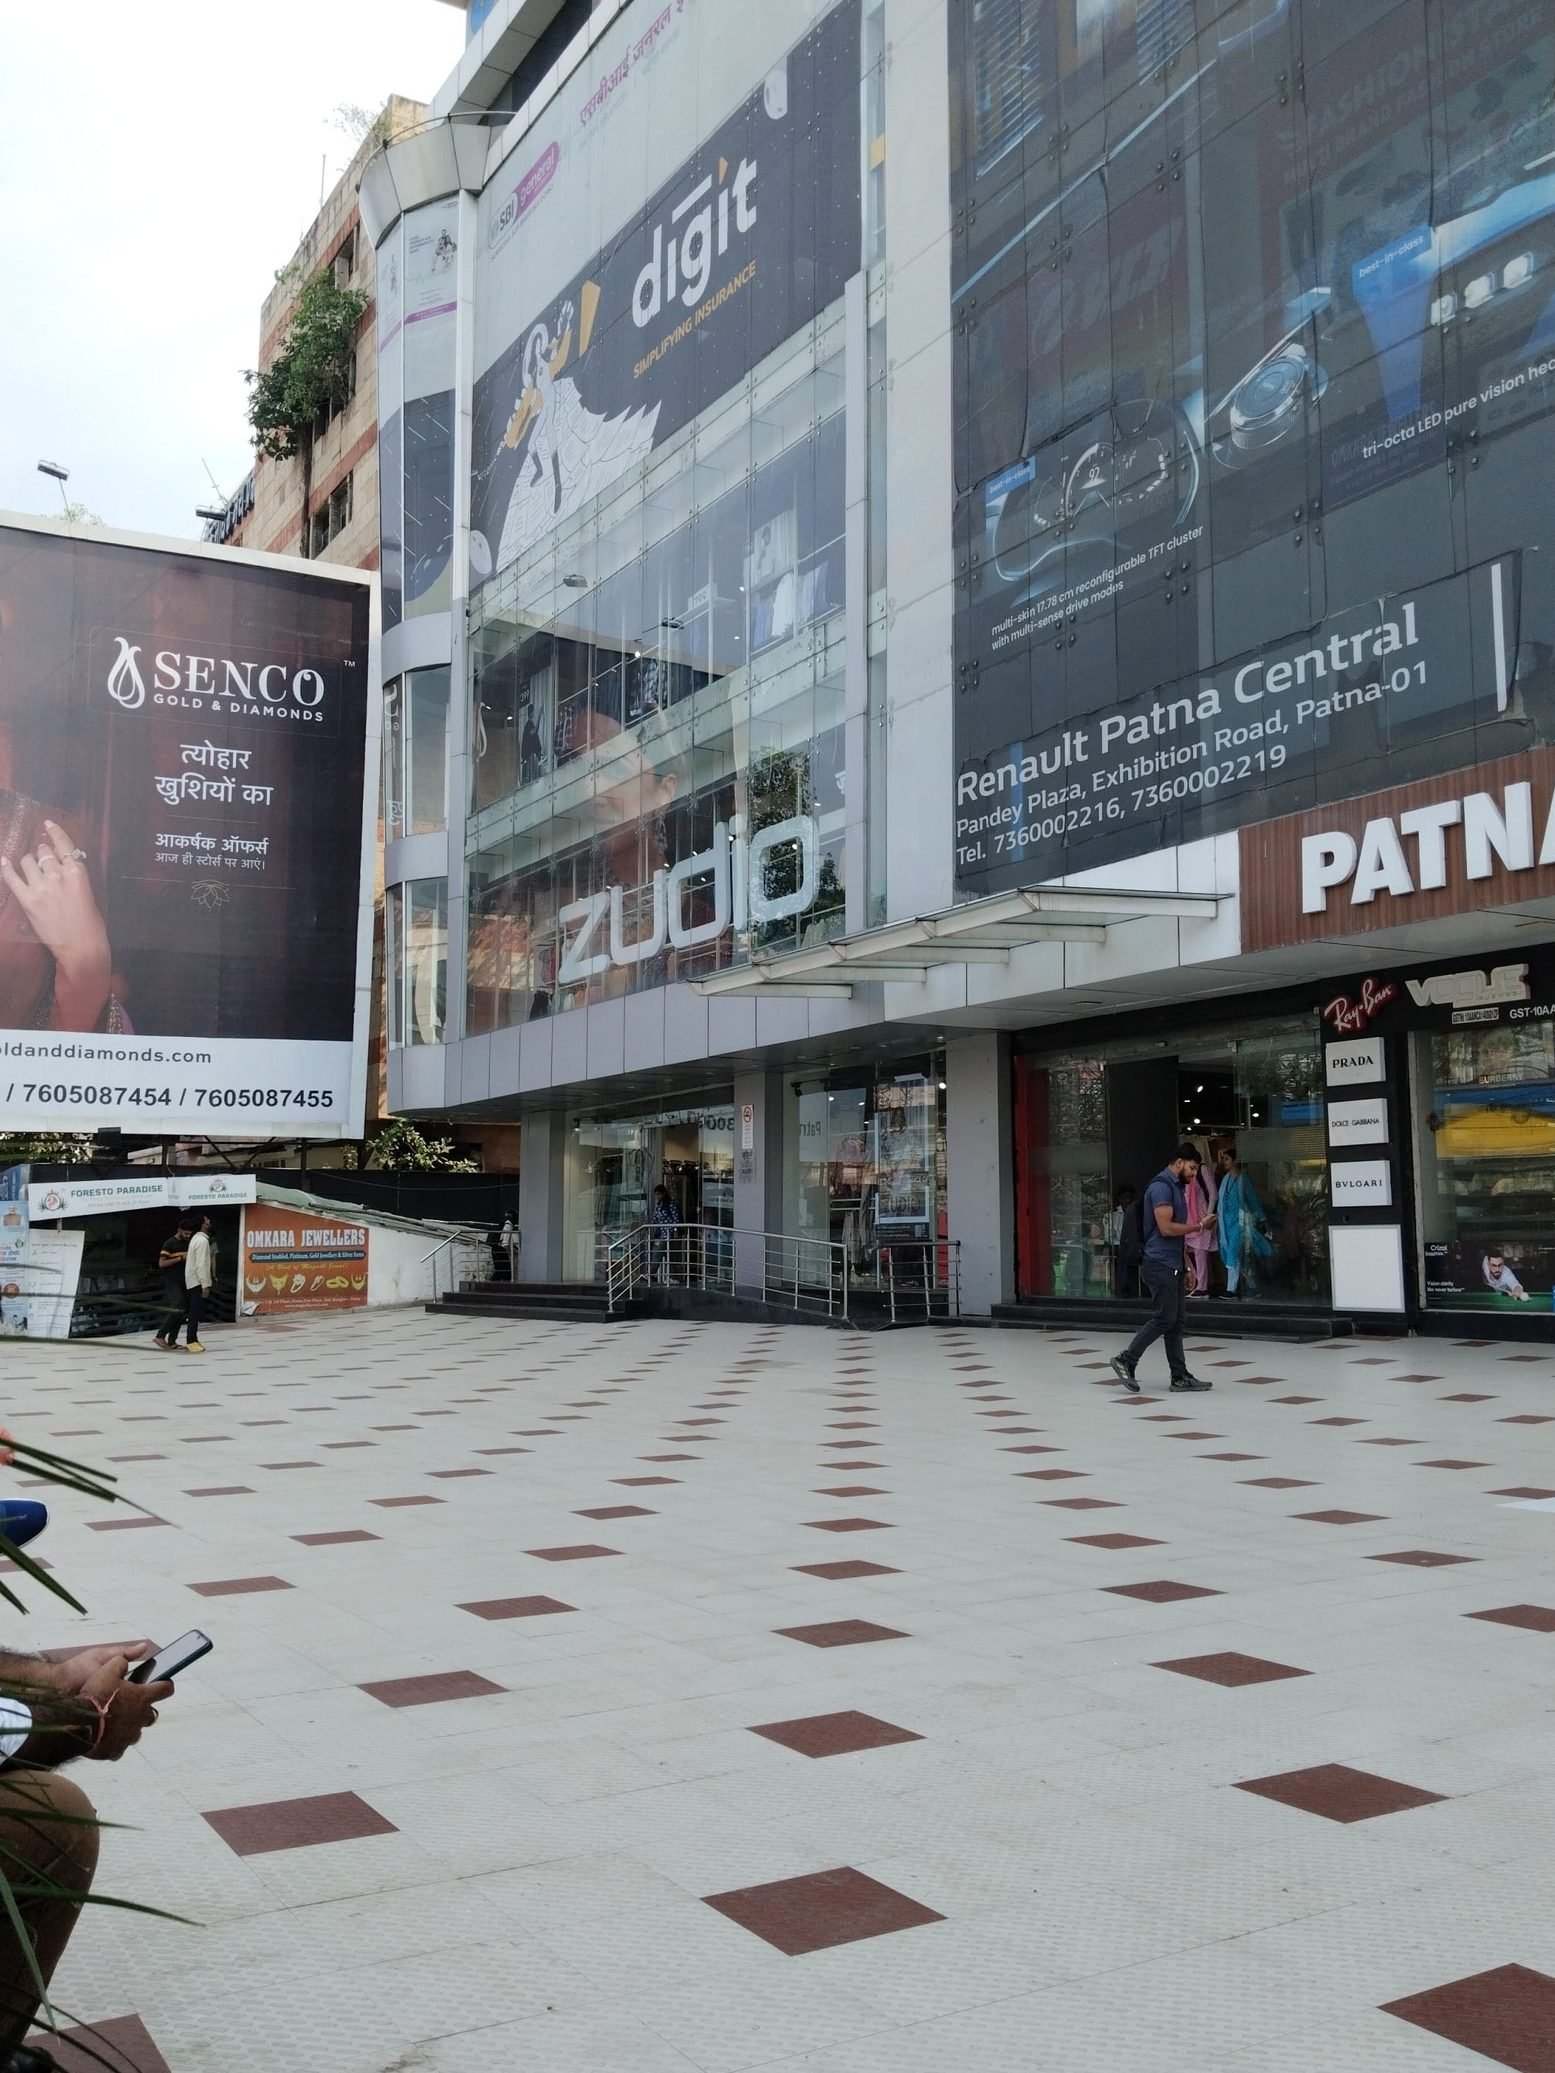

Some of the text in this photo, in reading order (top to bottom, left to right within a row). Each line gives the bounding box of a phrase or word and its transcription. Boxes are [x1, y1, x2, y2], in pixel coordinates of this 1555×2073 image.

[580, 44, 630, 127] एसबीआई
[631, 3, 672, 63] जनरल
[500, 147, 555, 231] SBI general
[632, 156, 757, 328] digit
[1359, 235, 1424, 278] best-in-class
[633, 260, 757, 379] SIMPLIFYING INSURANCE
[1363, 426, 1415, 458] tri-octa
[1418, 412, 1441, 433] LED
[1444, 396, 1477, 424] pure
[1480, 373, 1525, 402] vision
[991, 526, 1204, 636] multi-skin 17.78 cm reconfigurable TFT cluster
[991, 580, 1124, 651] with multi-sense drive modes
[153, 650, 325, 707] SENCO
[957, 601, 1421, 805] Renault Patna Central
[153, 693, 324, 722] GOLD & DIAMONDS
[180, 740, 252, 769] त्योहार
[957, 660, 1427, 838] Pandey Plaza, Exhibition Road, Patna-01
[154, 772, 274, 805] खुशियों का
[957, 744, 1287, 866] Tel. 7360002216, 7360002219
[155, 832, 270, 855] आकर्षक ऑफर्स
[155, 852, 179, 863] आज
[182, 851, 194, 865] ही
[224, 858, 239, 867] पर
[1301, 780, 1555, 914] PATN
[559, 813, 820, 984] zudio
[0, 1042, 212, 1064] ldanddiamonds.com
[1332, 1056, 1374, 1068] PRADA
[6, 1083, 334, 1108] / 7605087454 / 7605087455
[71, 1185, 163, 1198] FORESTO PARADISE
[1335, 1180, 1382, 1188] BVLGARI
[247, 1228, 366, 1248] OMKARA JEWELLERS
